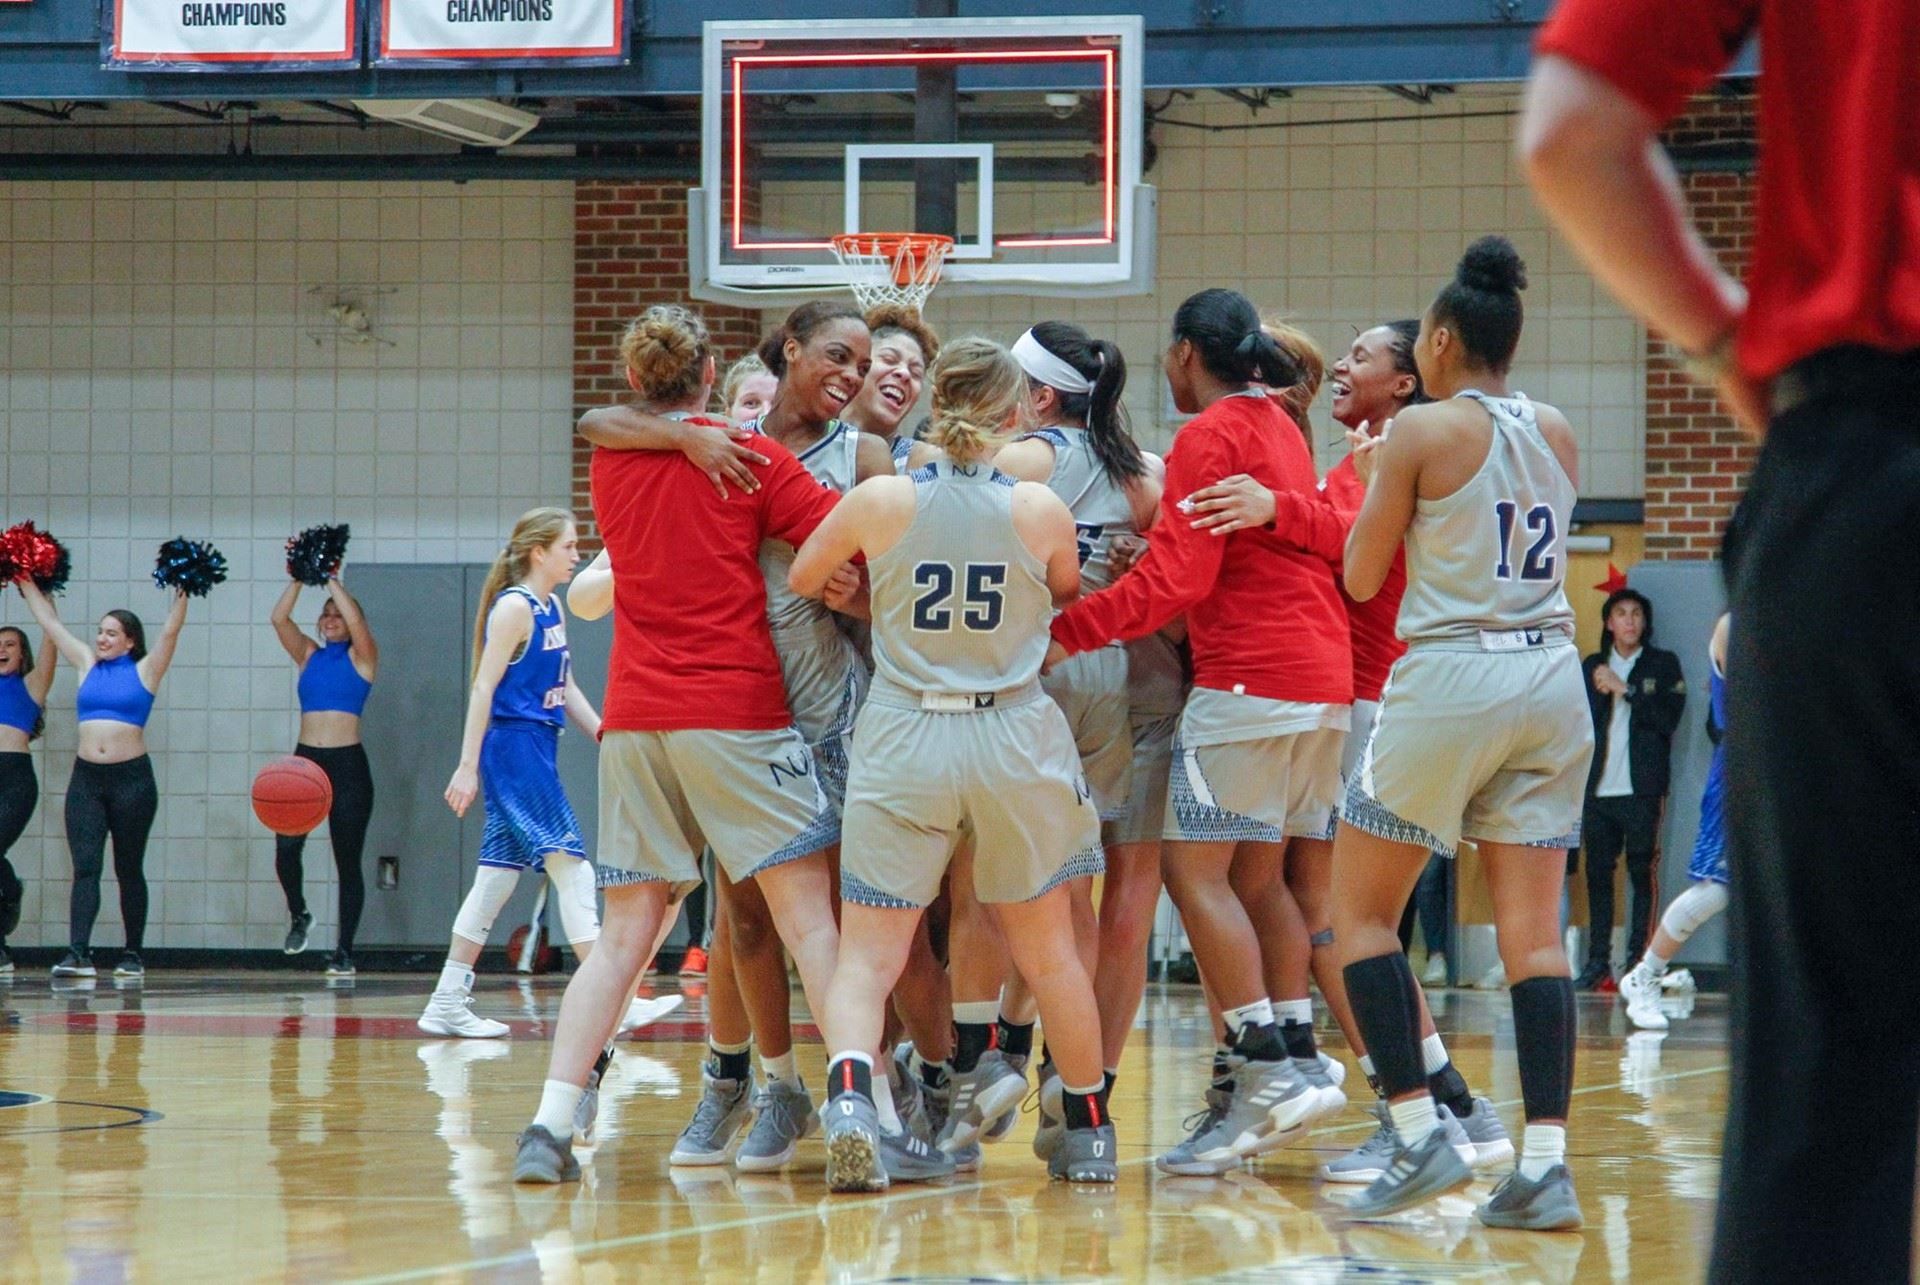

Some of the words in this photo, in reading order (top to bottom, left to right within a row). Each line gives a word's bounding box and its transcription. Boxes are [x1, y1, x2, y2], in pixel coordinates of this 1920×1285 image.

[182, 3, 286, 26] CHAMPIONS
[447, 0, 553, 22] CHAMPIONS
[1494, 499, 1557, 582] 12
[912, 559, 1009, 633] 25
